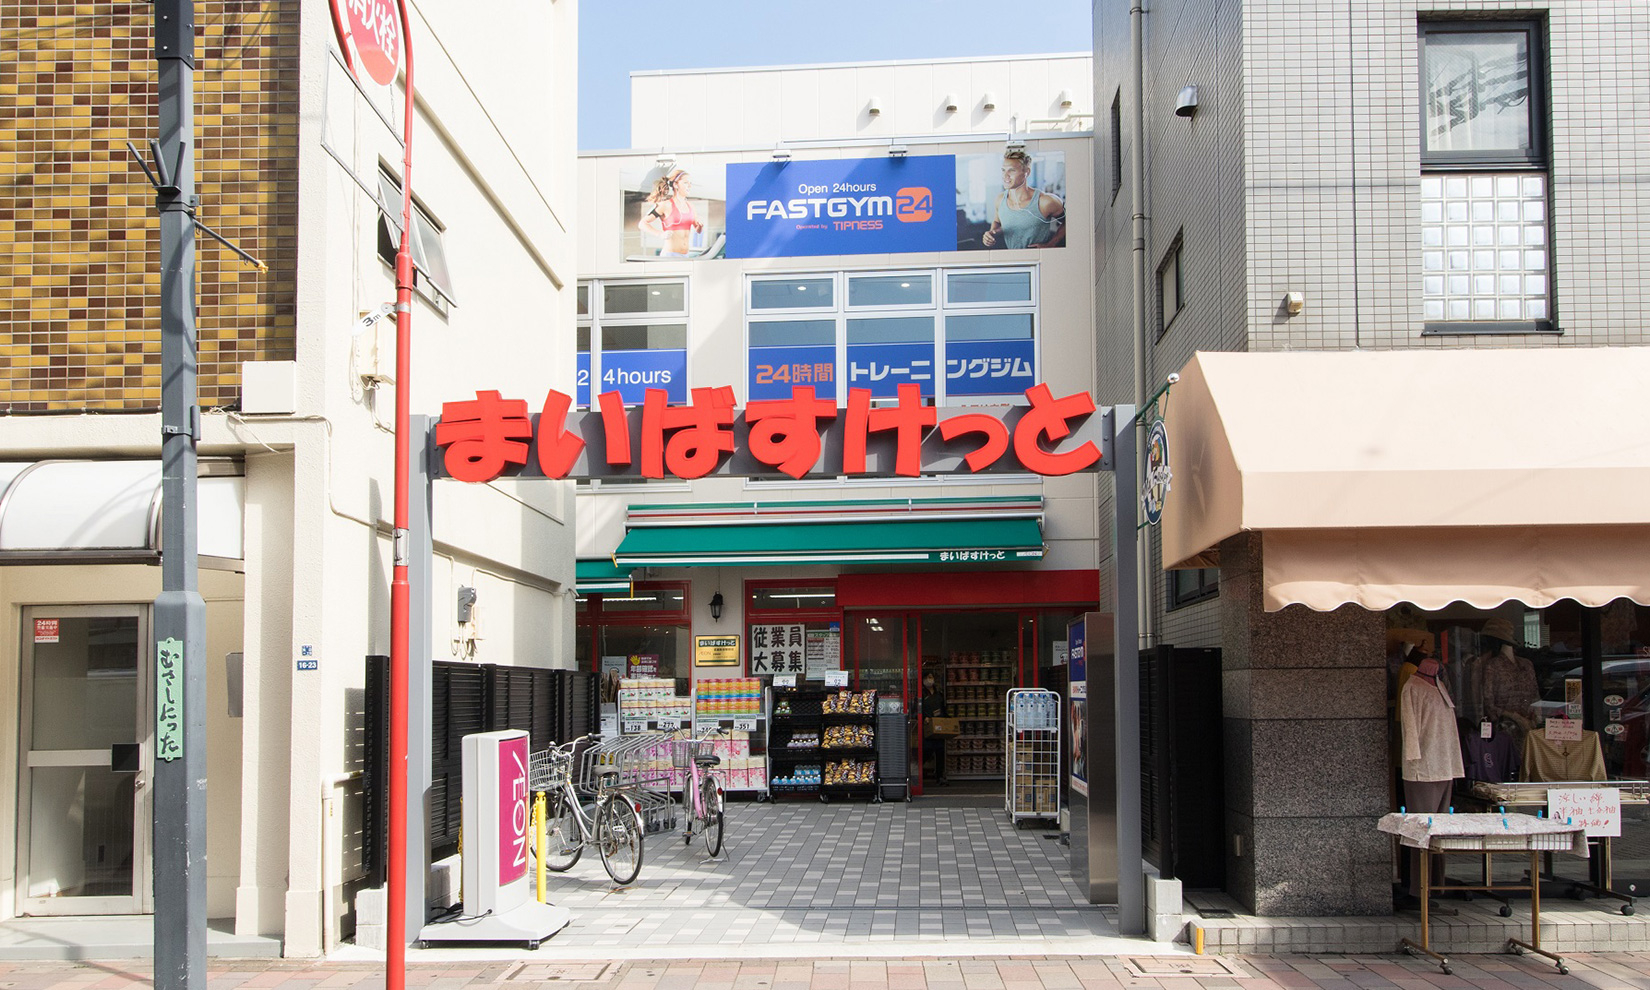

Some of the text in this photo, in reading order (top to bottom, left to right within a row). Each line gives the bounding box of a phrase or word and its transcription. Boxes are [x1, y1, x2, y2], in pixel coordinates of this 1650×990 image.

[798, 183, 877, 195] Open 24hours
[746, 196, 893, 220] FASTGYM
[833, 220, 884, 231] TIPNESS
[755, 362, 834, 384] 24時間
[436, 383, 1101, 482] まいばすけっと
[940, 550, 1005, 561] まいばすけっと
[753, 626, 803, 648] 従業員
[753, 650, 803, 672] 大募集
[160, 649, 180, 755] むさしにった
